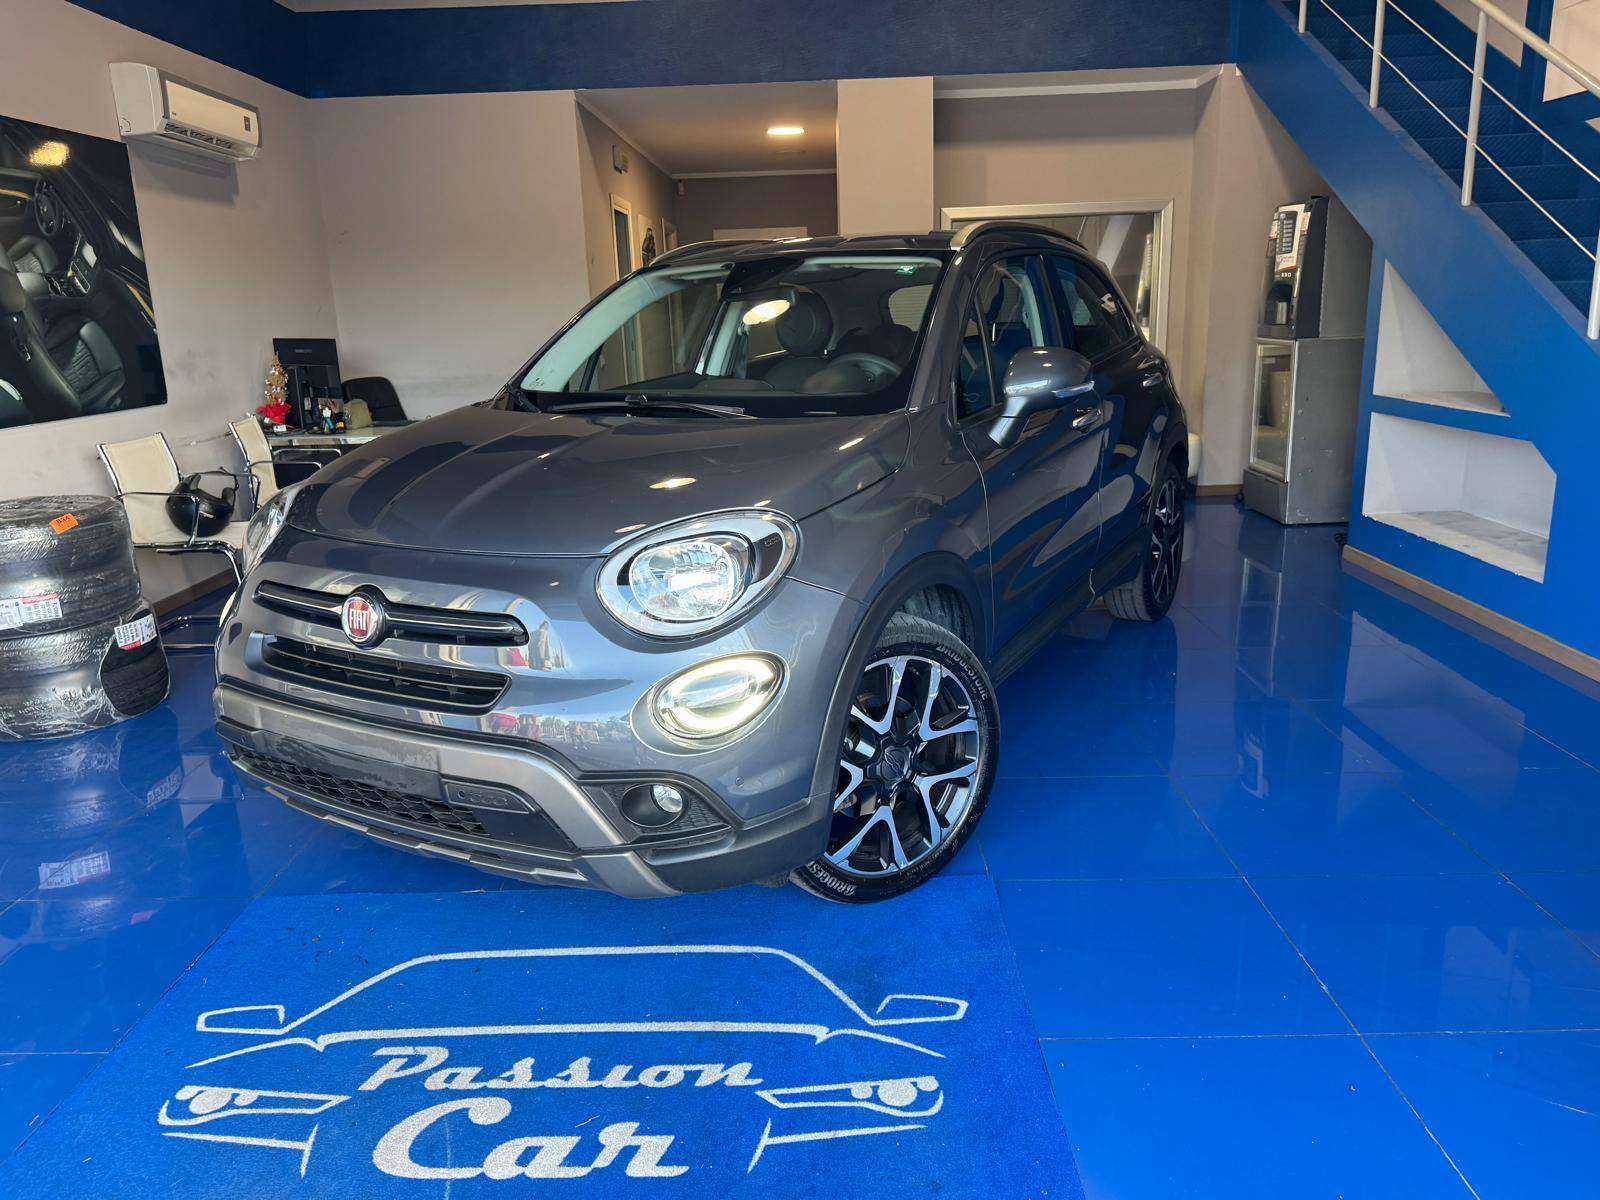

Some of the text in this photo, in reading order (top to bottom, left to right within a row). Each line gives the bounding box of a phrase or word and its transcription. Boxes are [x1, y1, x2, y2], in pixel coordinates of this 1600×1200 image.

[350, 609, 369, 630] FIAT
[358, 1046, 763, 1091] Passion
[372, 1096, 690, 1179] Car
